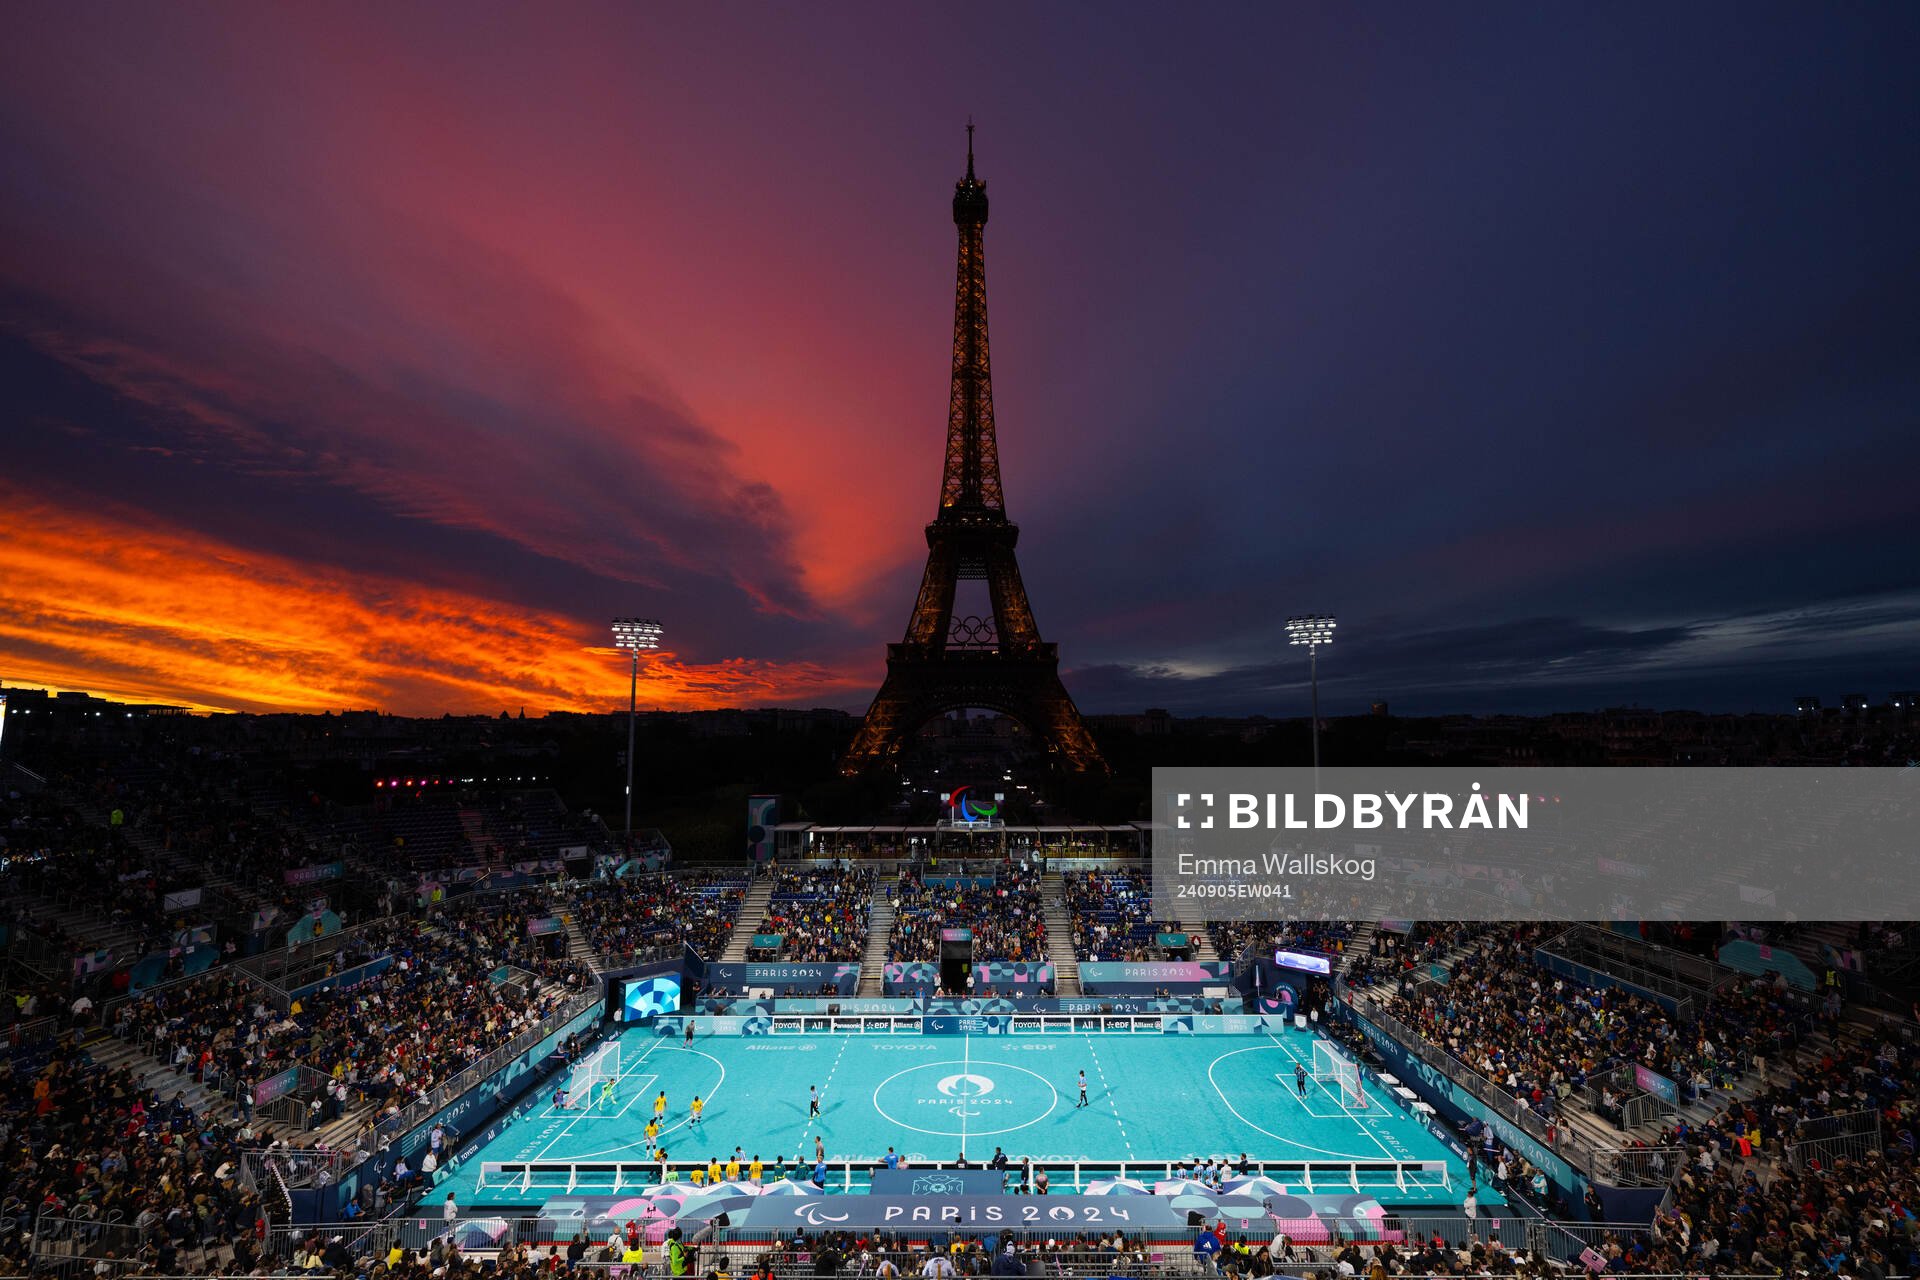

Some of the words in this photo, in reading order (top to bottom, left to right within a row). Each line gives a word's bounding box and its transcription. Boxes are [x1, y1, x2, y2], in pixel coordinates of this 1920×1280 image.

[792, 969, 822, 977] 2024
[1162, 967, 1192, 977] 2024
[774, 1022, 801, 1030] TOYOTA
[833, 1021, 862, 1030] Panasonic
[414, 1118, 444, 1147] PARS
[446, 1099, 471, 1124] 2024
[460, 1144, 479, 1161] TOYOTA
[1528, 1144, 1559, 1176] 2024
[1022, 1205, 1130, 1222] 2024
